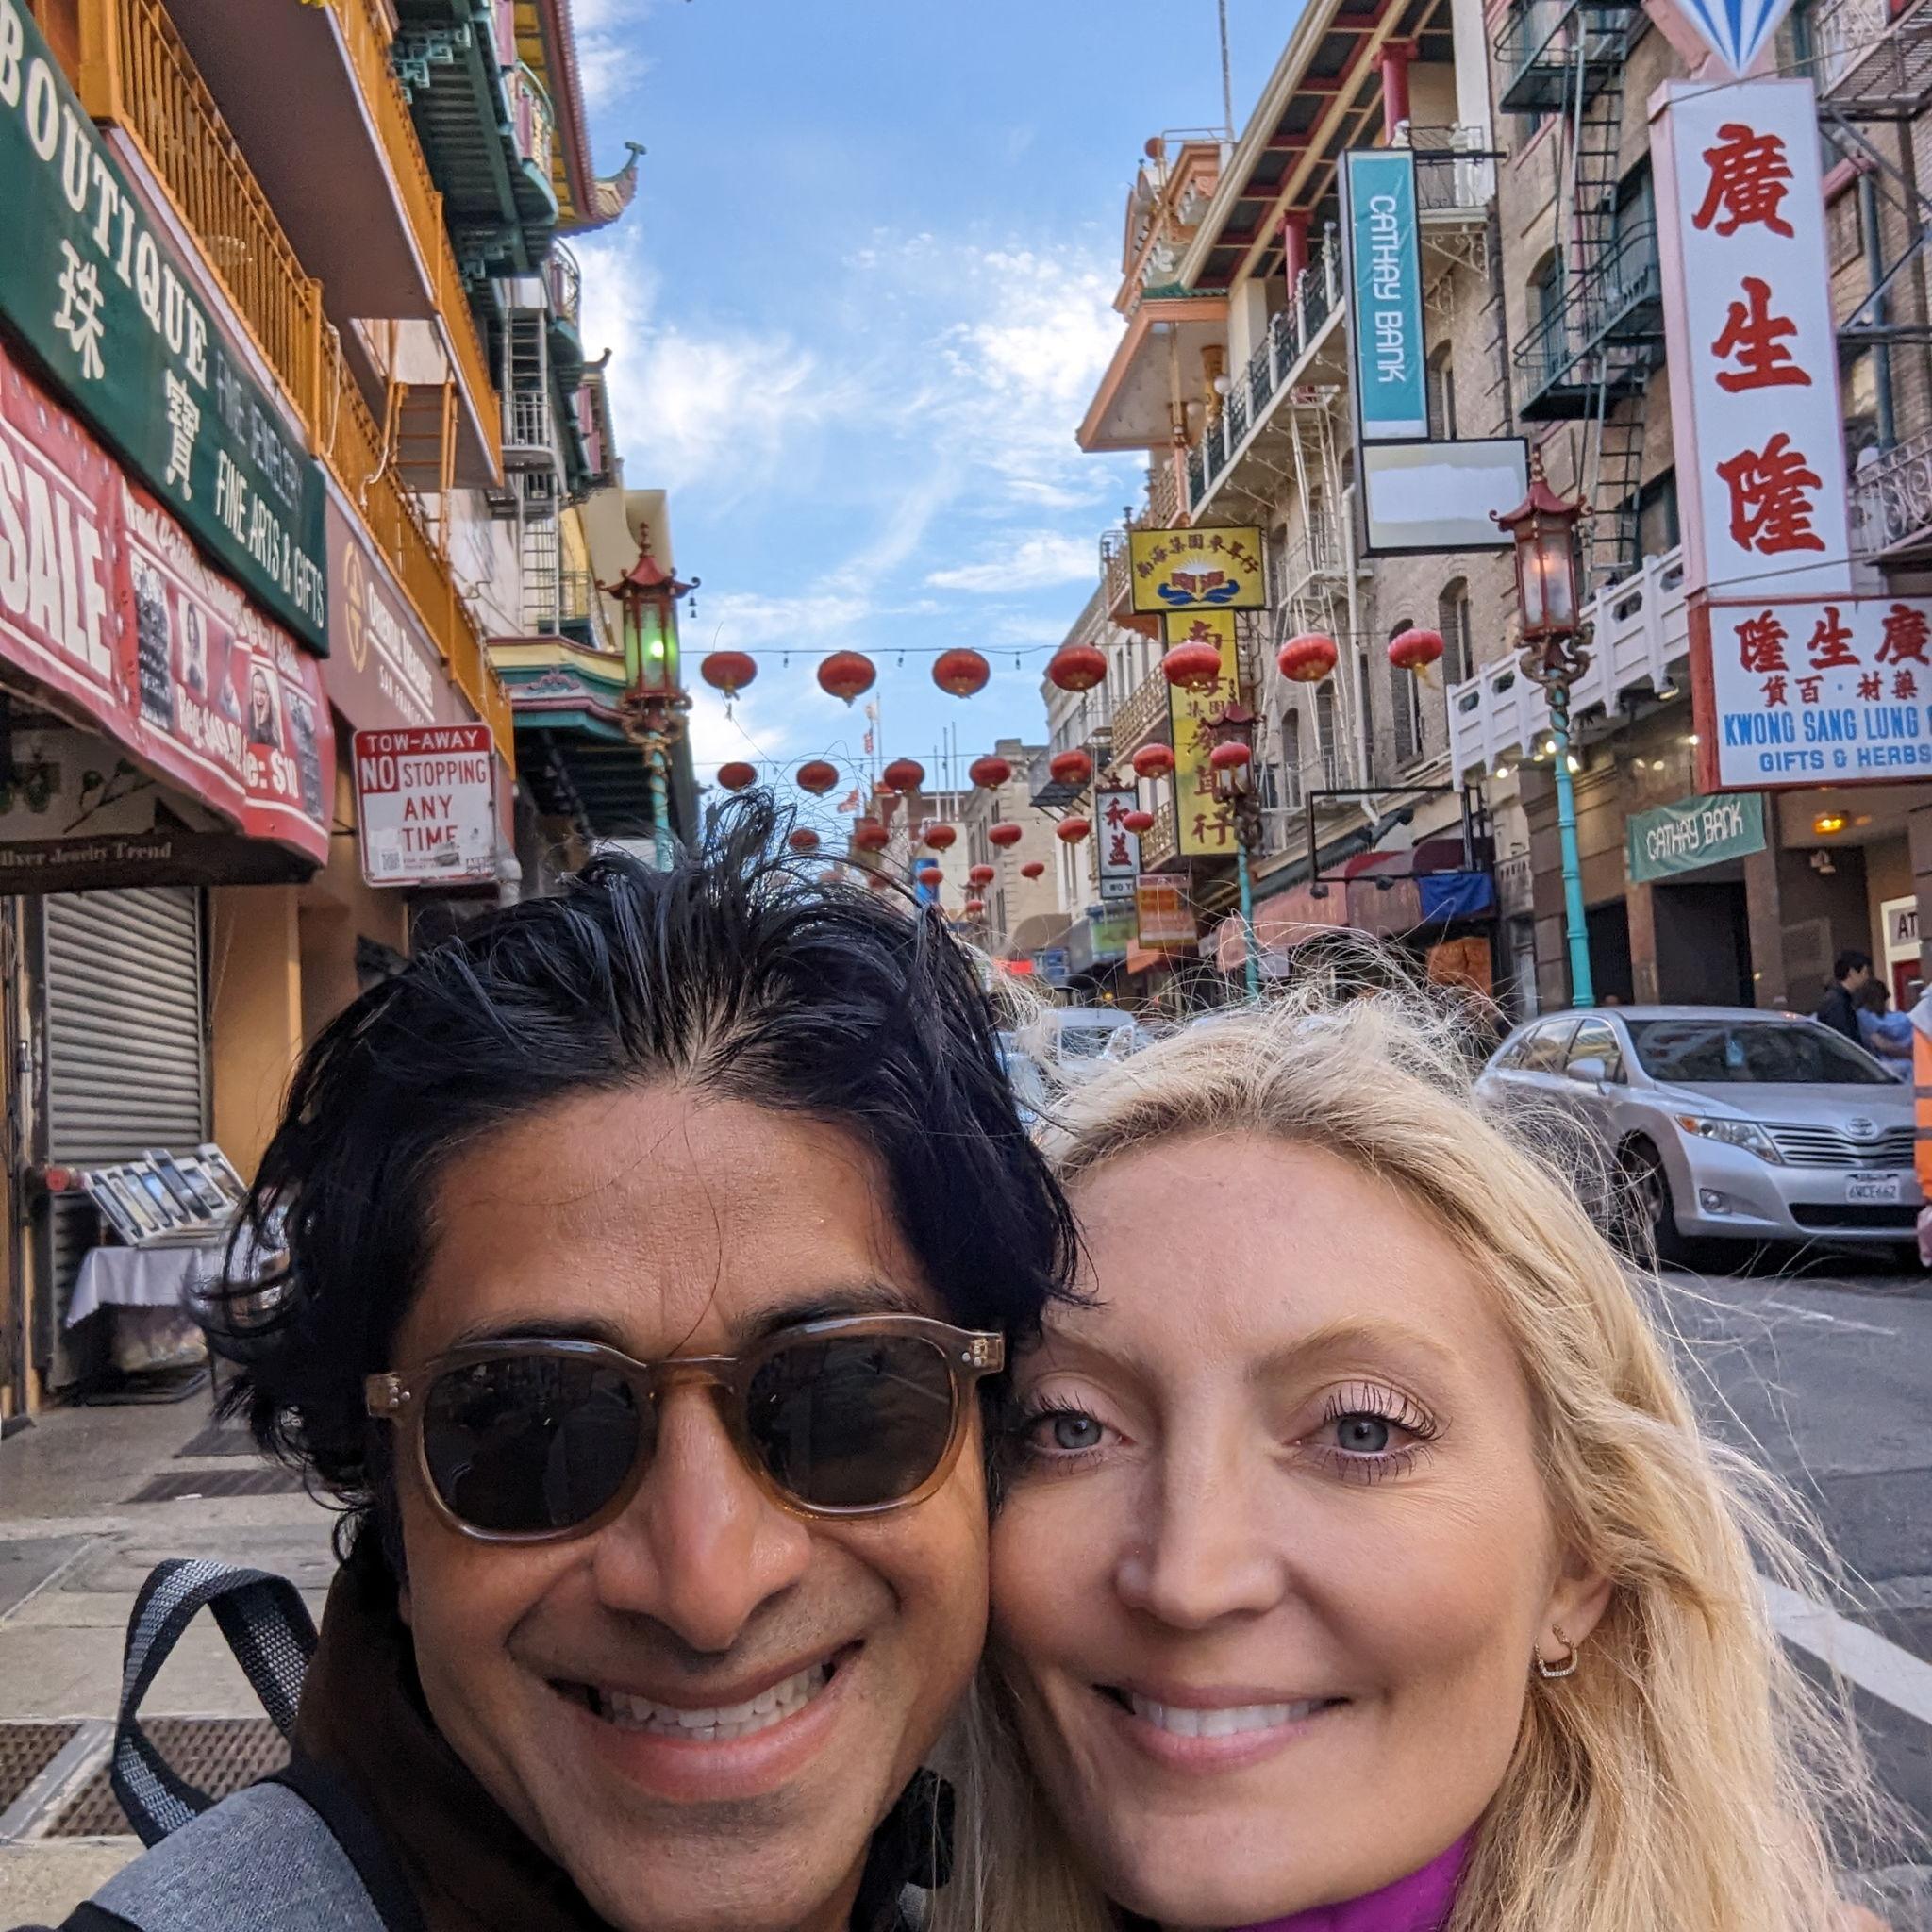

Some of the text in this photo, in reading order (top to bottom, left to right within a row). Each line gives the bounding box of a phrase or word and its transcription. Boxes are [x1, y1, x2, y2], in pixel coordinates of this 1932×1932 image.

[1369, 195, 1406, 383] CATHAY BANK
[1692, 124, 1825, 554] 廣生隆
[216, 448, 324, 629] FINE ARTS & GIFTS
[367, 730, 478, 753] TOW-AWAY
[1724, 711, 1795, 746] KWONG
[1803, 708, 1857, 742] SANG
[1864, 706, 1919, 740] LUNG
[360, 755, 487, 791] NO STOPPING
[1760, 743, 1932, 772] GIFTS & HERBS
[404, 793, 453, 822] ANY
[402, 824, 458, 852] TIME
[1646, 802, 1743, 861] CATHAY BANK
[1898, 911, 1918, 940] AT
